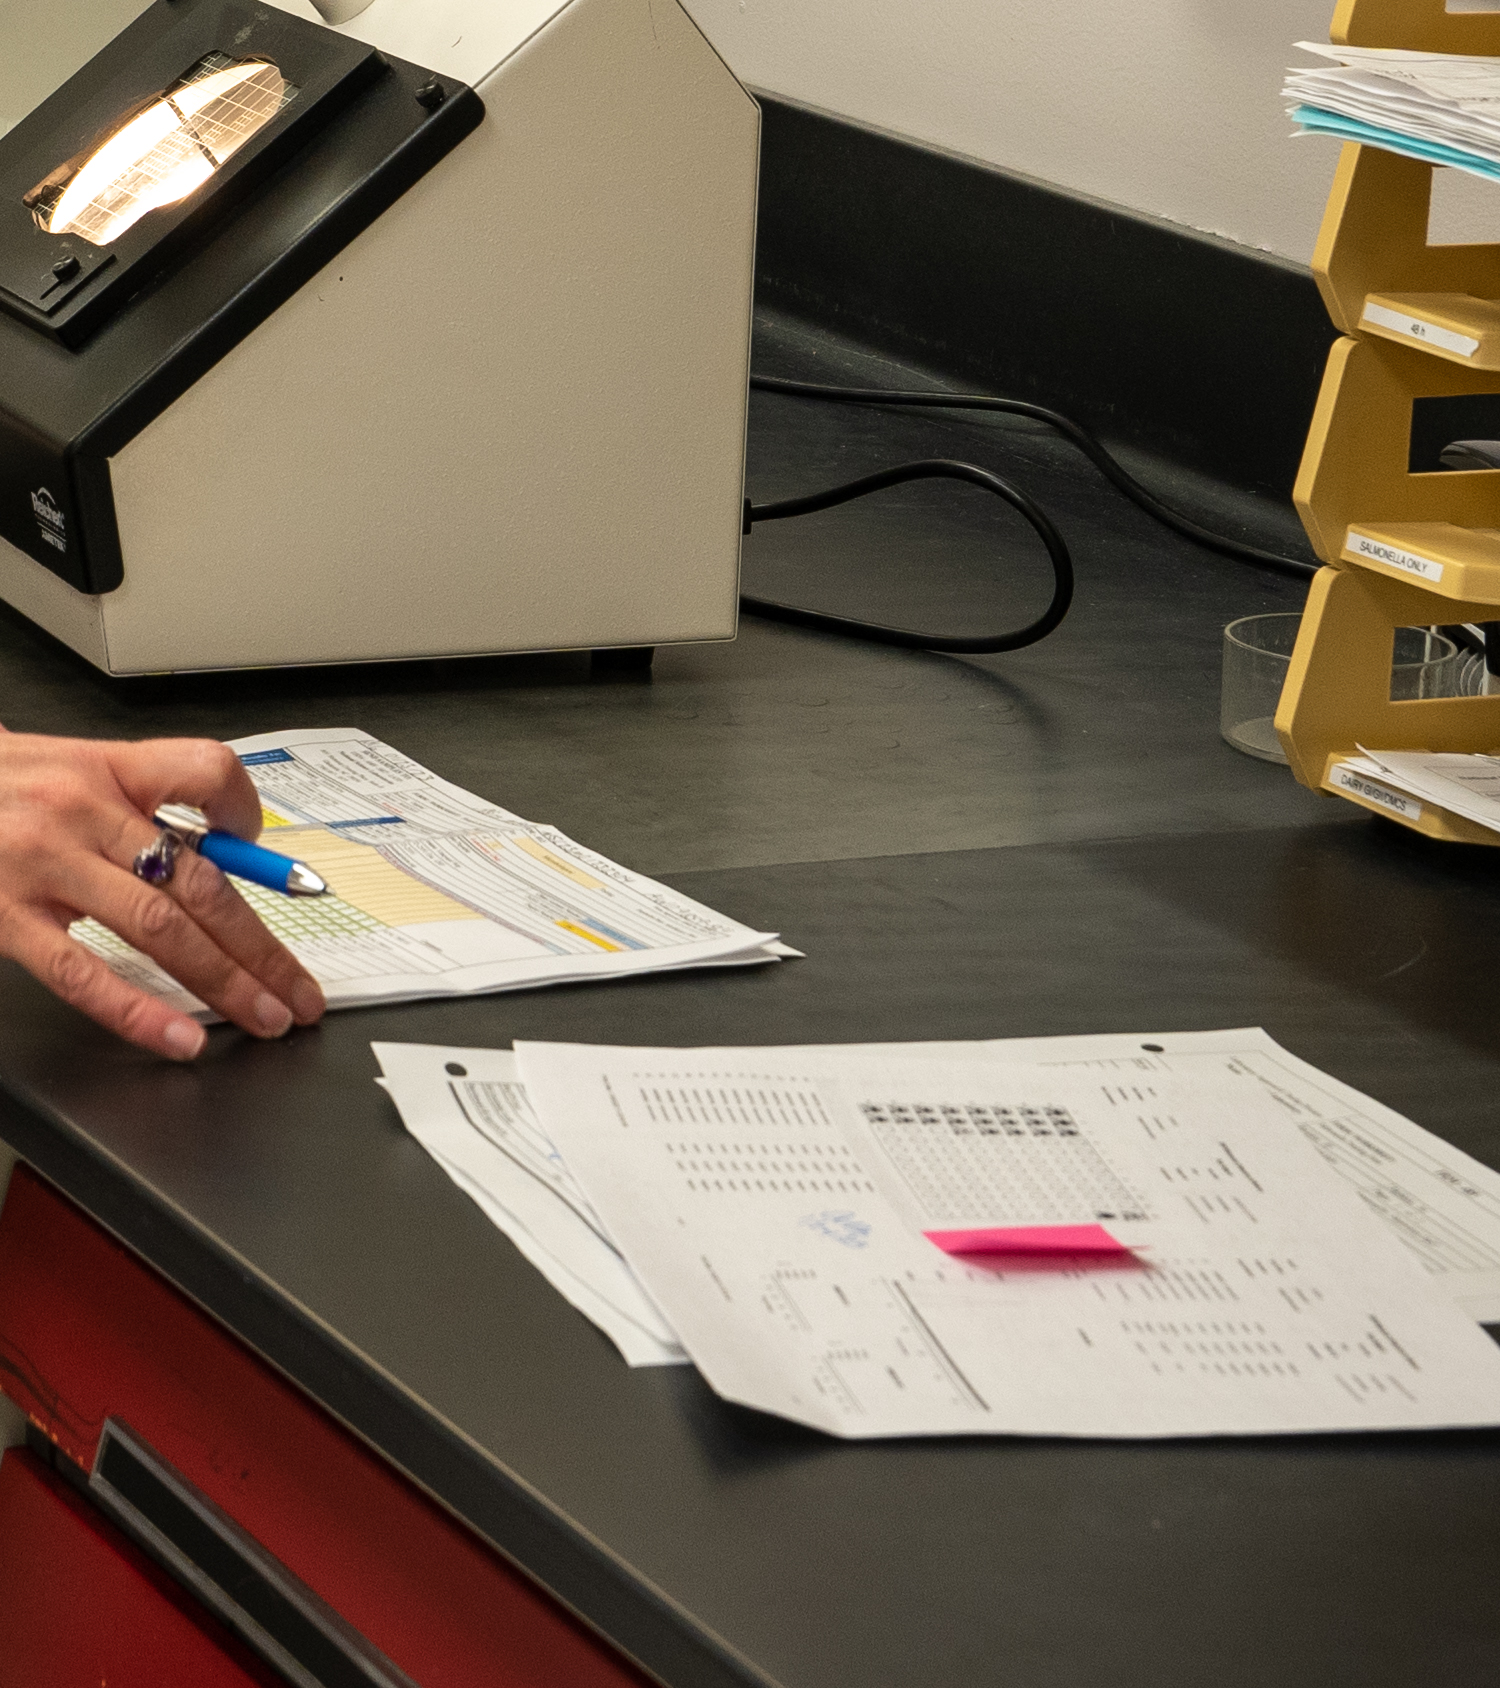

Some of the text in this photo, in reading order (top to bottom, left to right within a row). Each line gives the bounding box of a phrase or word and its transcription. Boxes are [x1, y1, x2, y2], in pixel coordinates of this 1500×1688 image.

[1359, 541, 1428, 573] SALMONELLA ONLY
[1341, 774, 1363, 792] DAIRY
